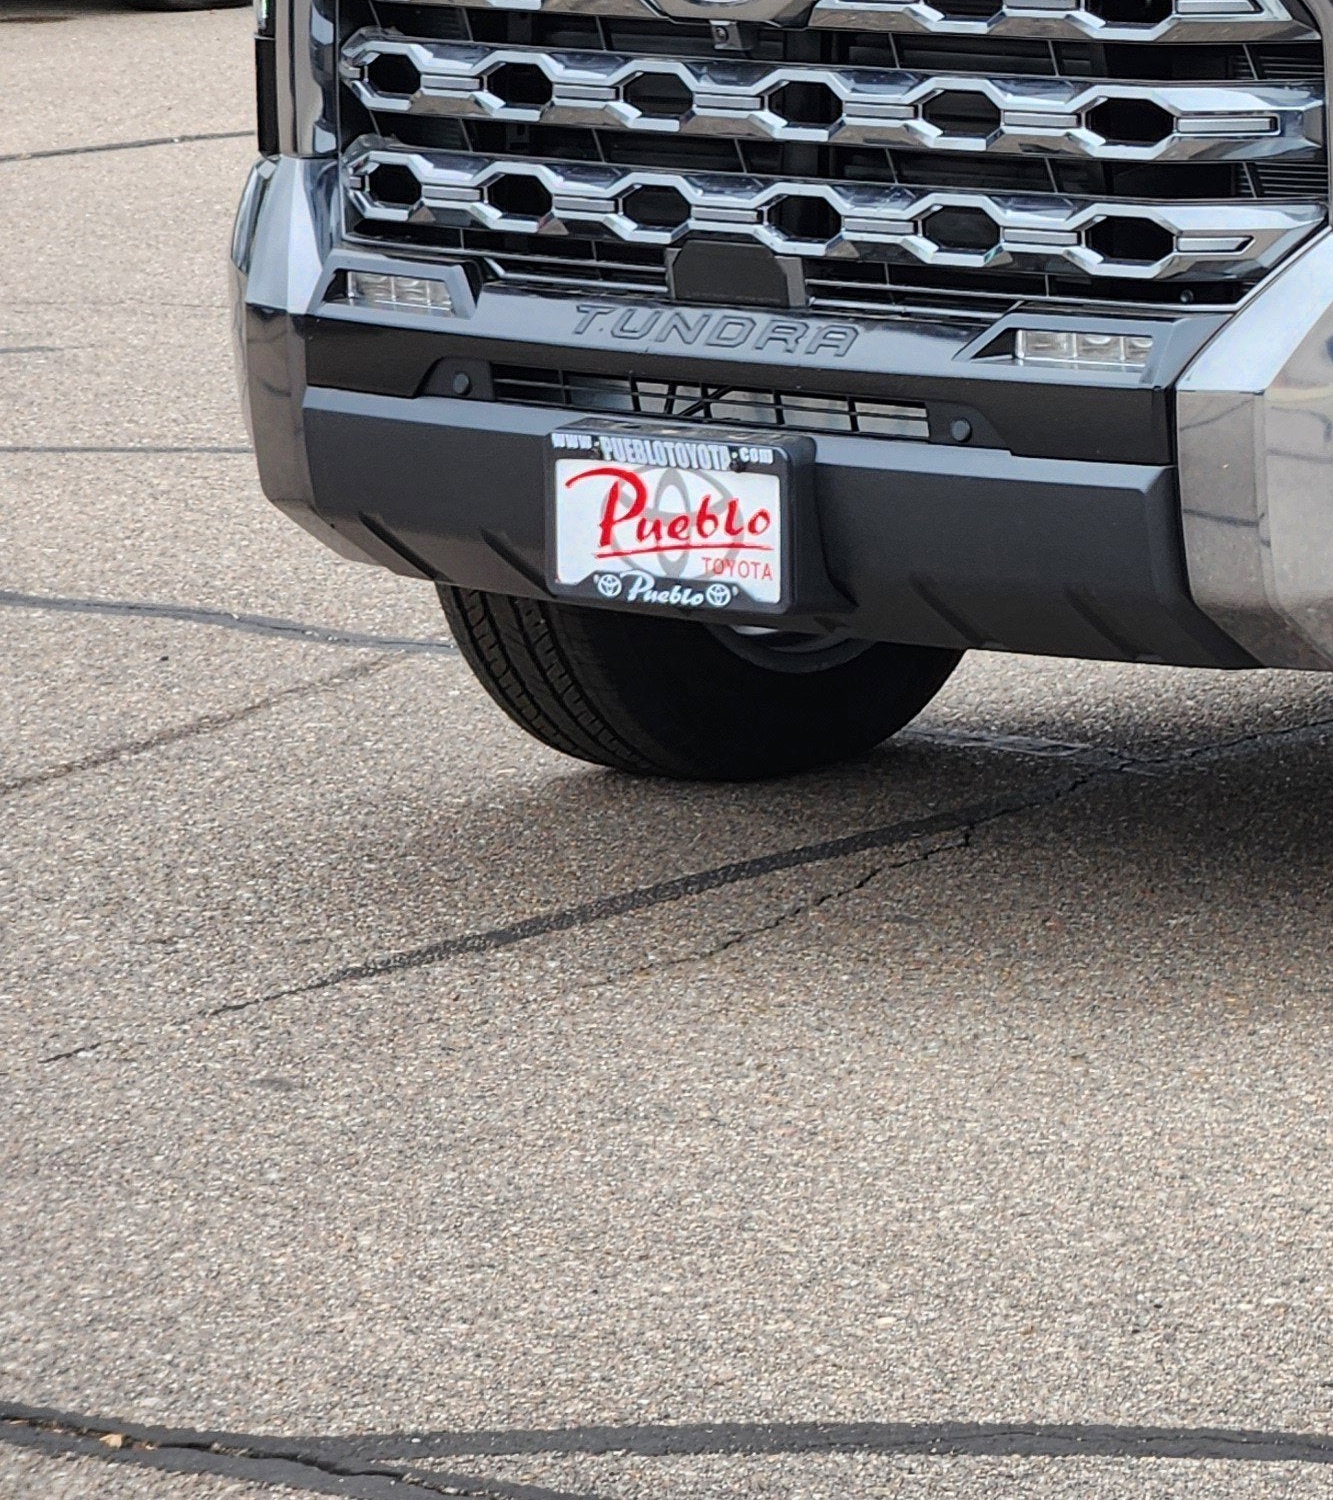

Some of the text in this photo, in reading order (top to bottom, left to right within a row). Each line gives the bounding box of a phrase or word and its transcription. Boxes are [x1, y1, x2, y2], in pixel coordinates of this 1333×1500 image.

[575, 304, 861, 357] TUNDRA
[565, 467, 772, 550] Pueblo
[620, 570, 704, 606] Pueblo
[702, 557, 772, 581] TOYOTA
